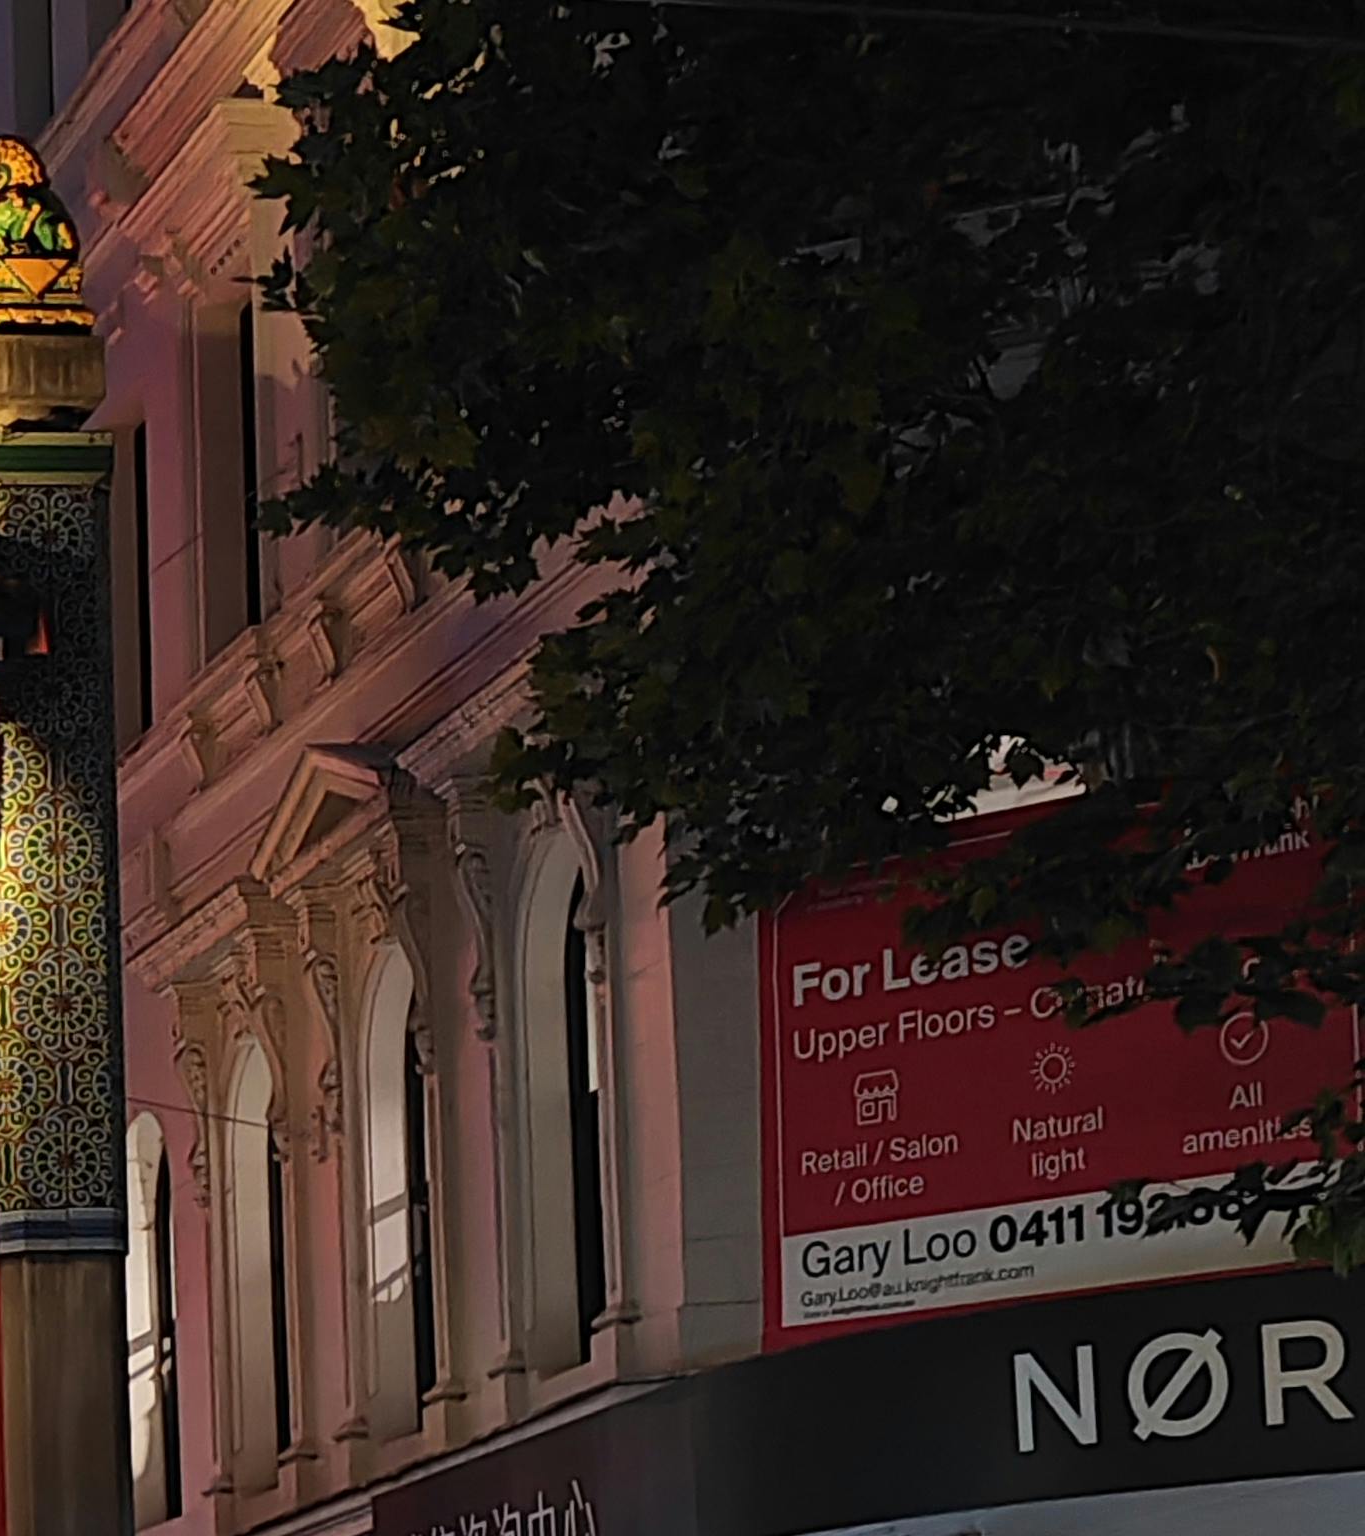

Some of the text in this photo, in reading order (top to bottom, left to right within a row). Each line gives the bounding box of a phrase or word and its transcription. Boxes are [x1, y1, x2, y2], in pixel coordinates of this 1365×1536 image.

[793, 934, 1030, 1007] For Lease
[793, 1022, 890, 1062] Upper
[898, 1003, 995, 1043] Floors
[1229, 1081, 1262, 1110] All
[1013, 1106, 1104, 1144] Natural
[802, 1140, 867, 1175] Retail
[890, 1133, 959, 1163] Salon
[1032, 1147, 1086, 1180] light
[852, 1175, 924, 1203] Office
[801, 1239, 891, 1278] Gary
[903, 1227, 977, 1265] Loo
[989, 1204, 1085, 1253] 0411
